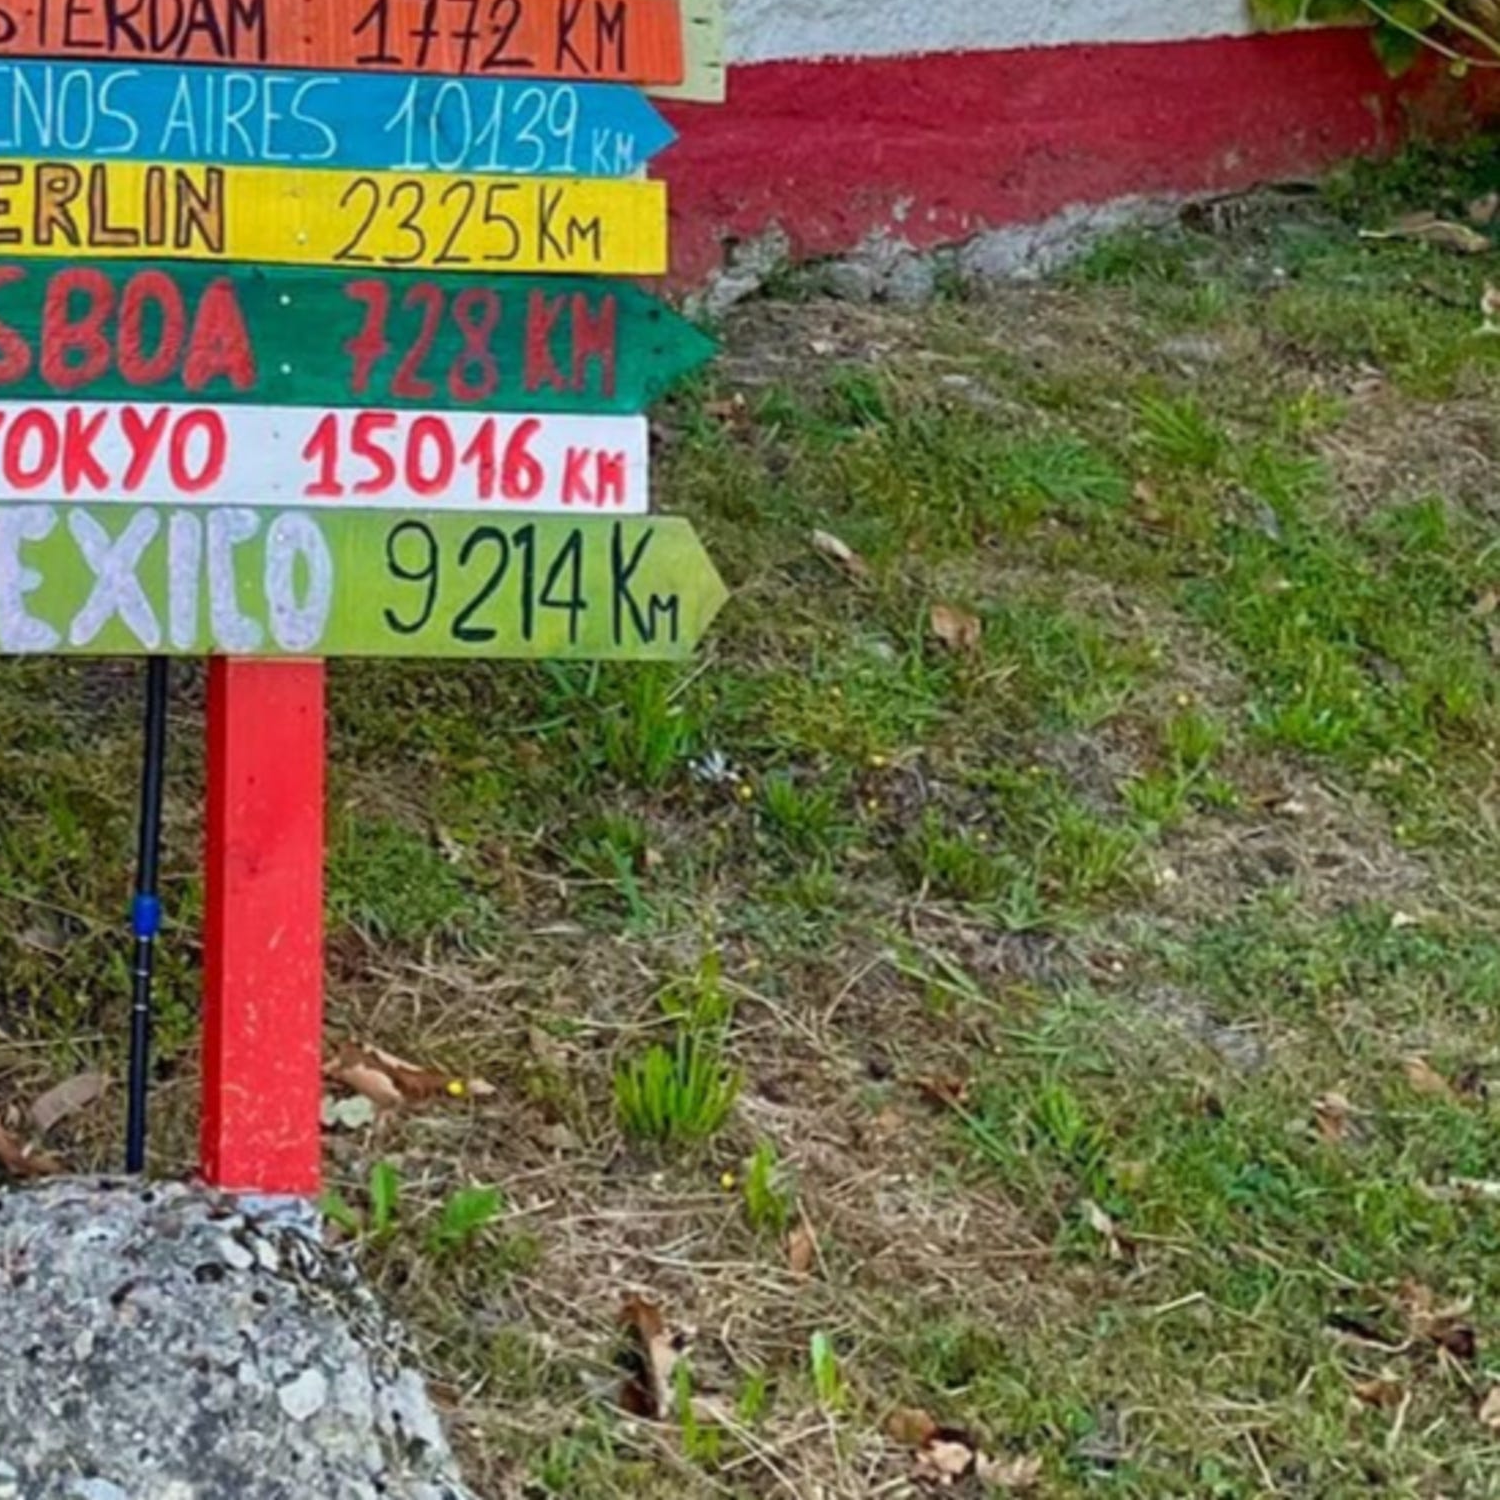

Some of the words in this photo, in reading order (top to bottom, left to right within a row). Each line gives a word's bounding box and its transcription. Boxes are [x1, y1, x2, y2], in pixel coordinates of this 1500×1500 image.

[158, 73, 340, 160] AIRES
[383, 80, 579, 173] 10139
[333, 180, 522, 262] 2325
[343, 279, 502, 403] 728
[522, 287, 617, 397] KM
[301, 414, 545, 499] 15016
[384, 519, 587, 648] 9214
